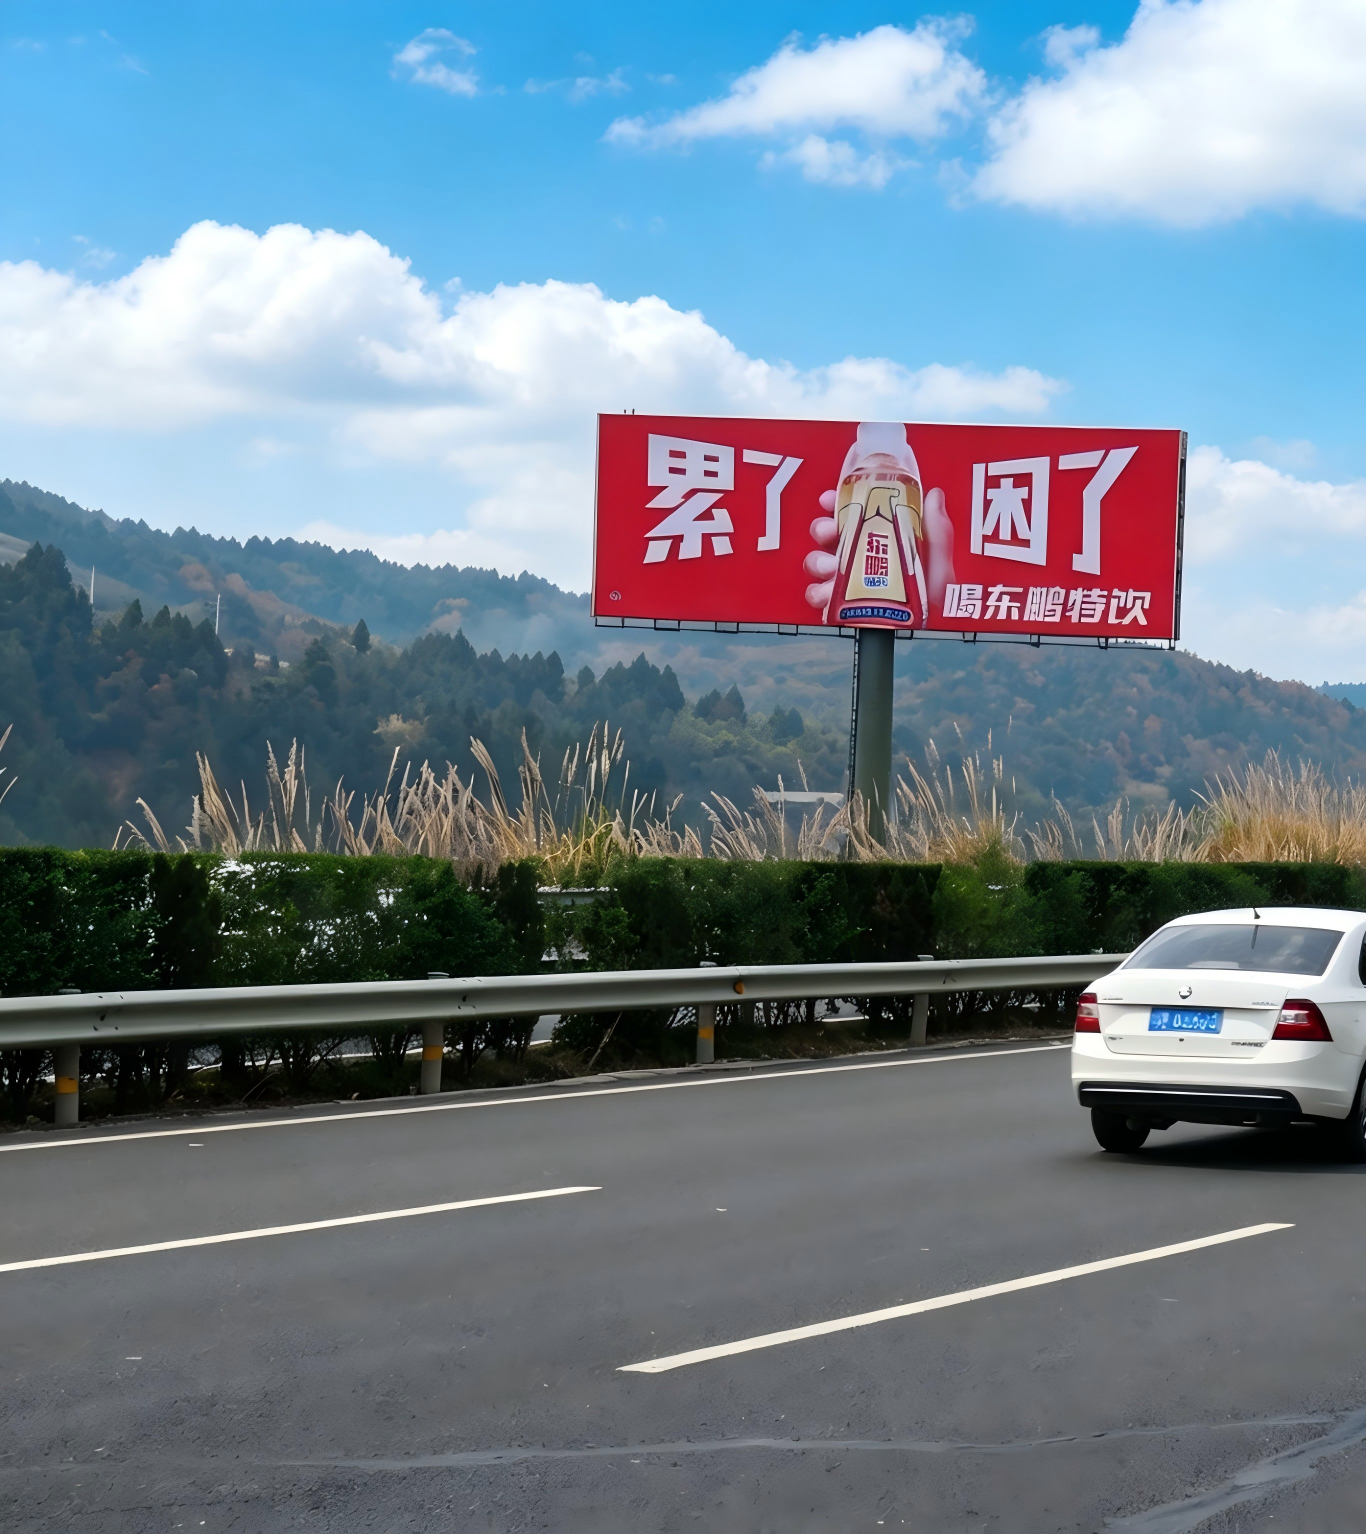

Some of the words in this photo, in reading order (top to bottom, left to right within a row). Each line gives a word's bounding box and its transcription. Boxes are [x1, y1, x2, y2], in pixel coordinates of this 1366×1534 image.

[642, 433, 804, 564] 累了
[970, 446, 1139, 576] 困了
[942, 583, 1151, 626] 喝东鹏特饮
